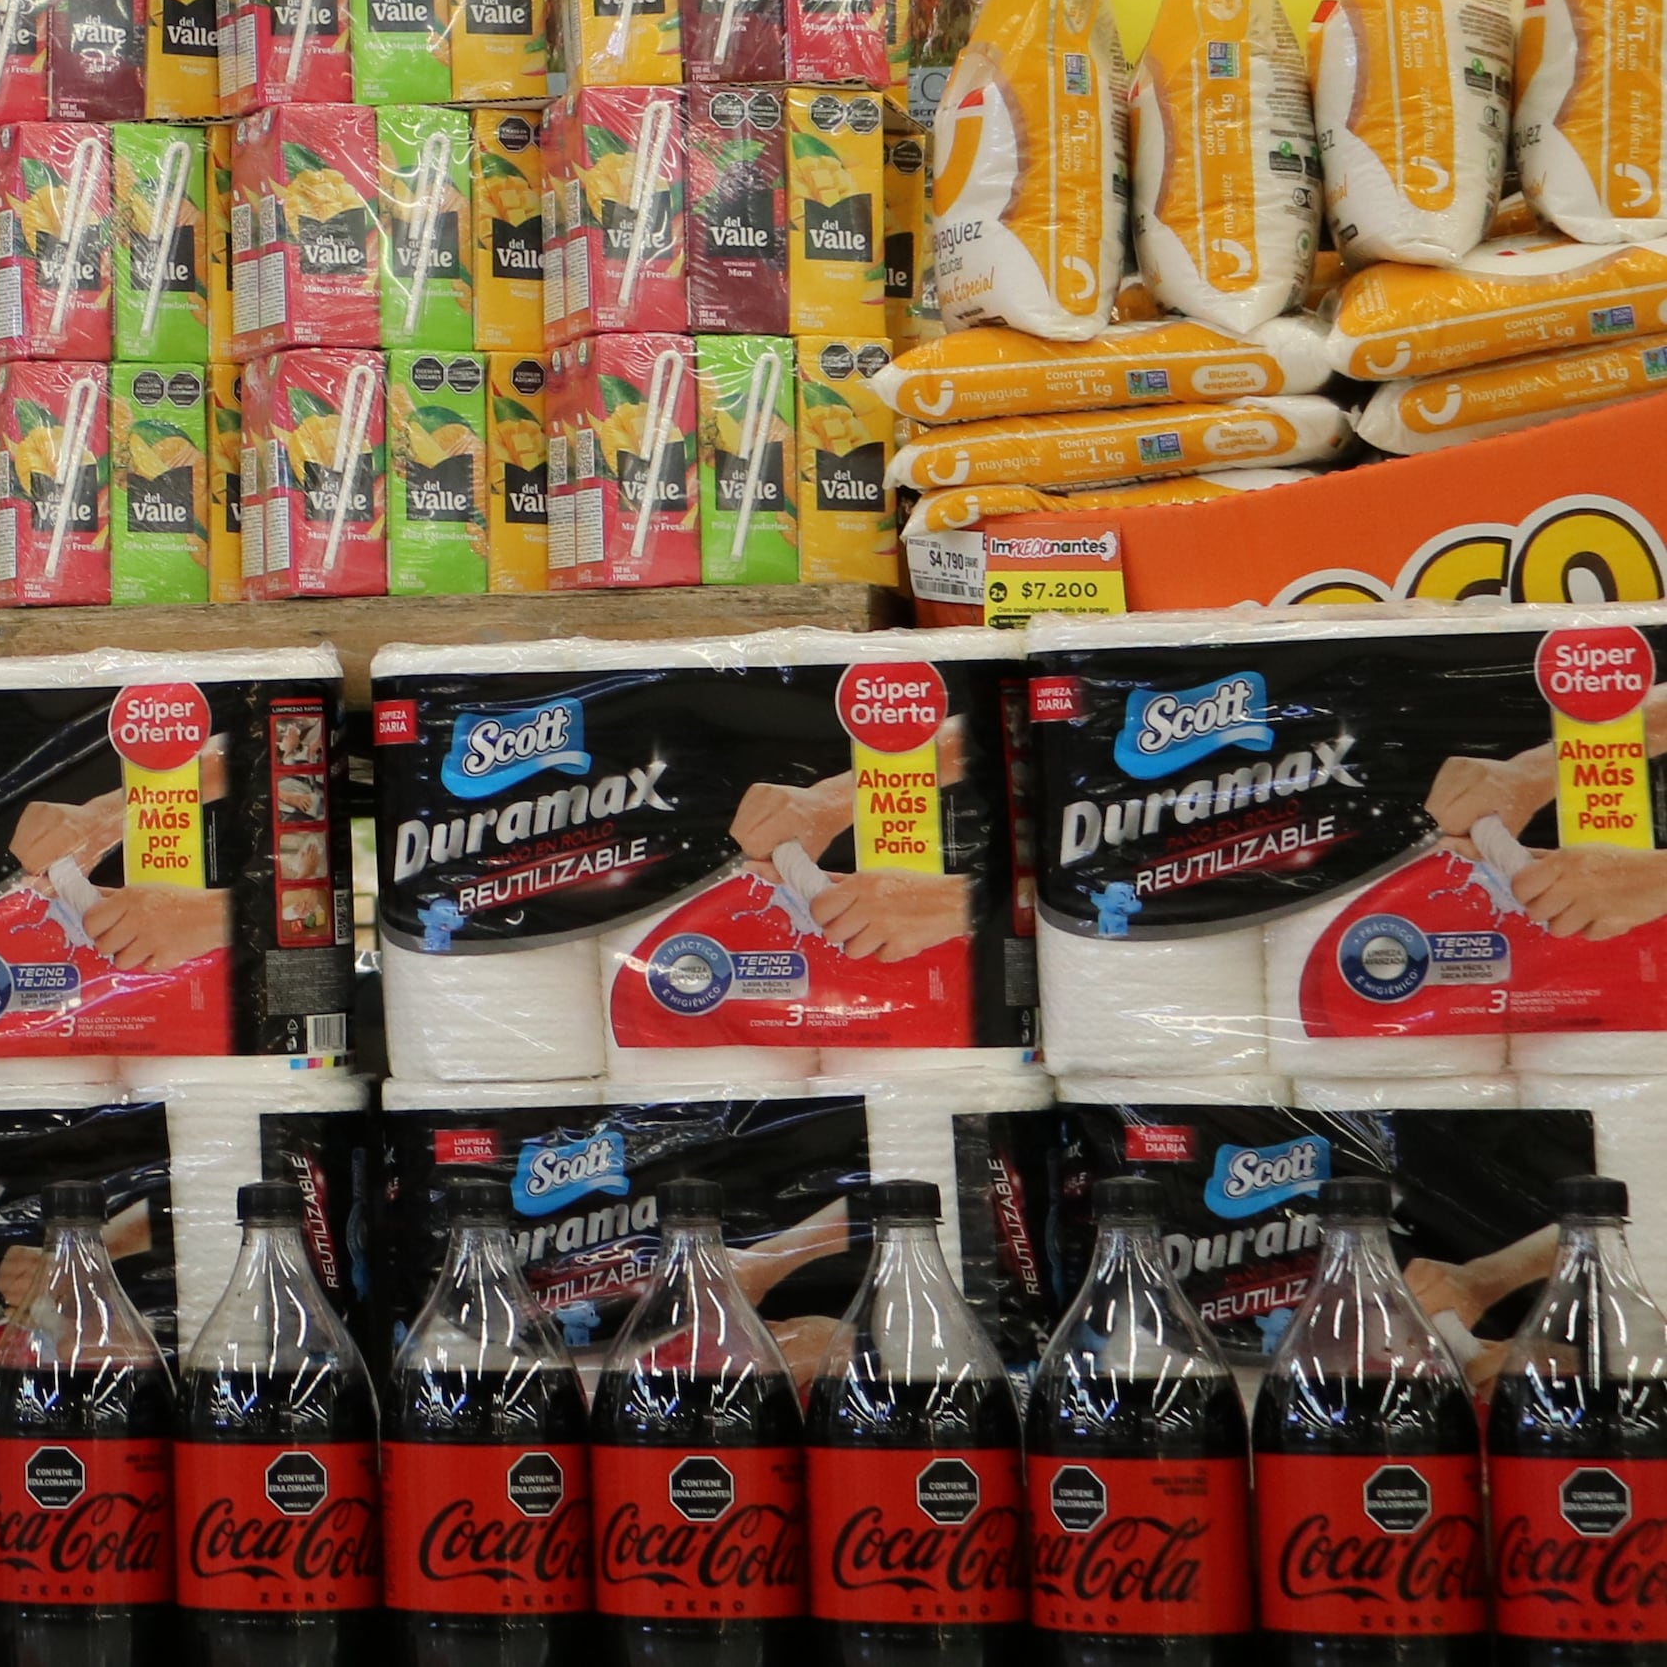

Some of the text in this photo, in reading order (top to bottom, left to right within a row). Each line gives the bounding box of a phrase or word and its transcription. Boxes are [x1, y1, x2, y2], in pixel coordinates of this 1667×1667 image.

[724, 217, 741, 229] del
[710, 227, 767, 249] Valle
[1021, 582, 1098, 599] $7.200
[856, 676, 931, 704] Súper
[850, 702, 937, 725] Oferta
[1136, 679, 1252, 754] Scott
[460, 705, 569, 776] Scott
[857, 769, 936, 790] Ahorra
[870, 791, 927, 815] Más
[1059, 735, 1364, 868] Duramax
[394, 758, 667, 885] Duramax
[882, 817, 916, 838] por
[873, 836, 926, 856] Paño
[1135, 815, 1336, 897] REUTILIZABLE
[458, 837, 649, 915] REUTILIZABLE
[681, 1478, 722, 1488] CONTIENE
[665, 1600, 745, 1612] ZERO
